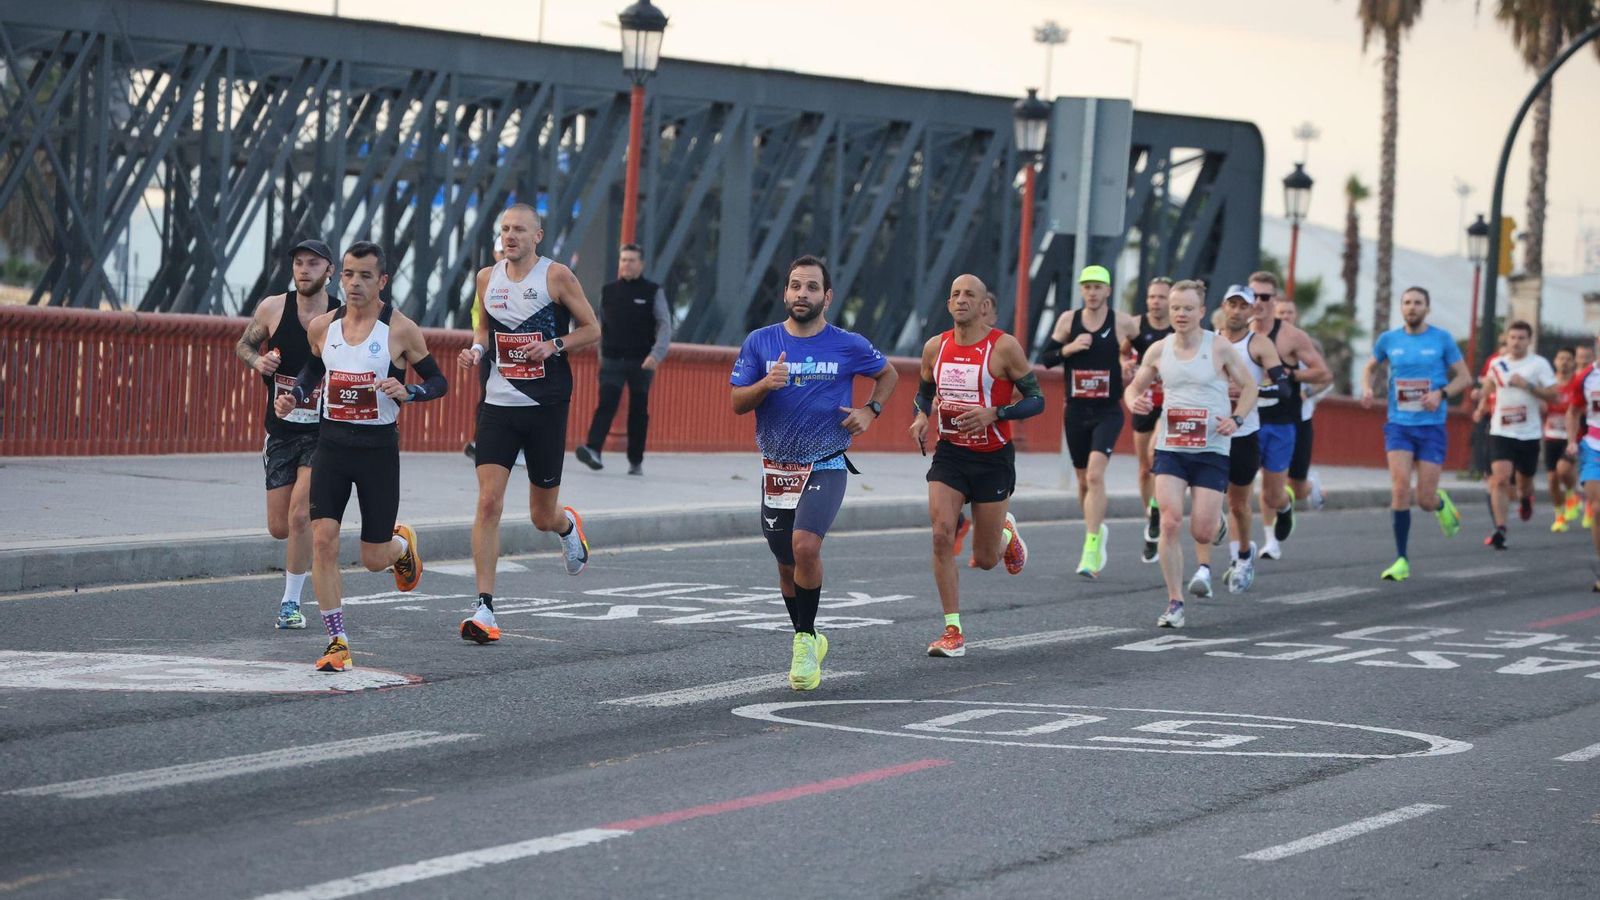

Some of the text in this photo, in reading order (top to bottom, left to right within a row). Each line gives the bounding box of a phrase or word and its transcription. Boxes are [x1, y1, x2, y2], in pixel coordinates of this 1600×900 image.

[338, 373, 371, 383] GENERALI
[802, 374, 836, 382] MARBELLA
[339, 389, 359, 400] 292
[1111, 634, 1600, 680] ASICA
